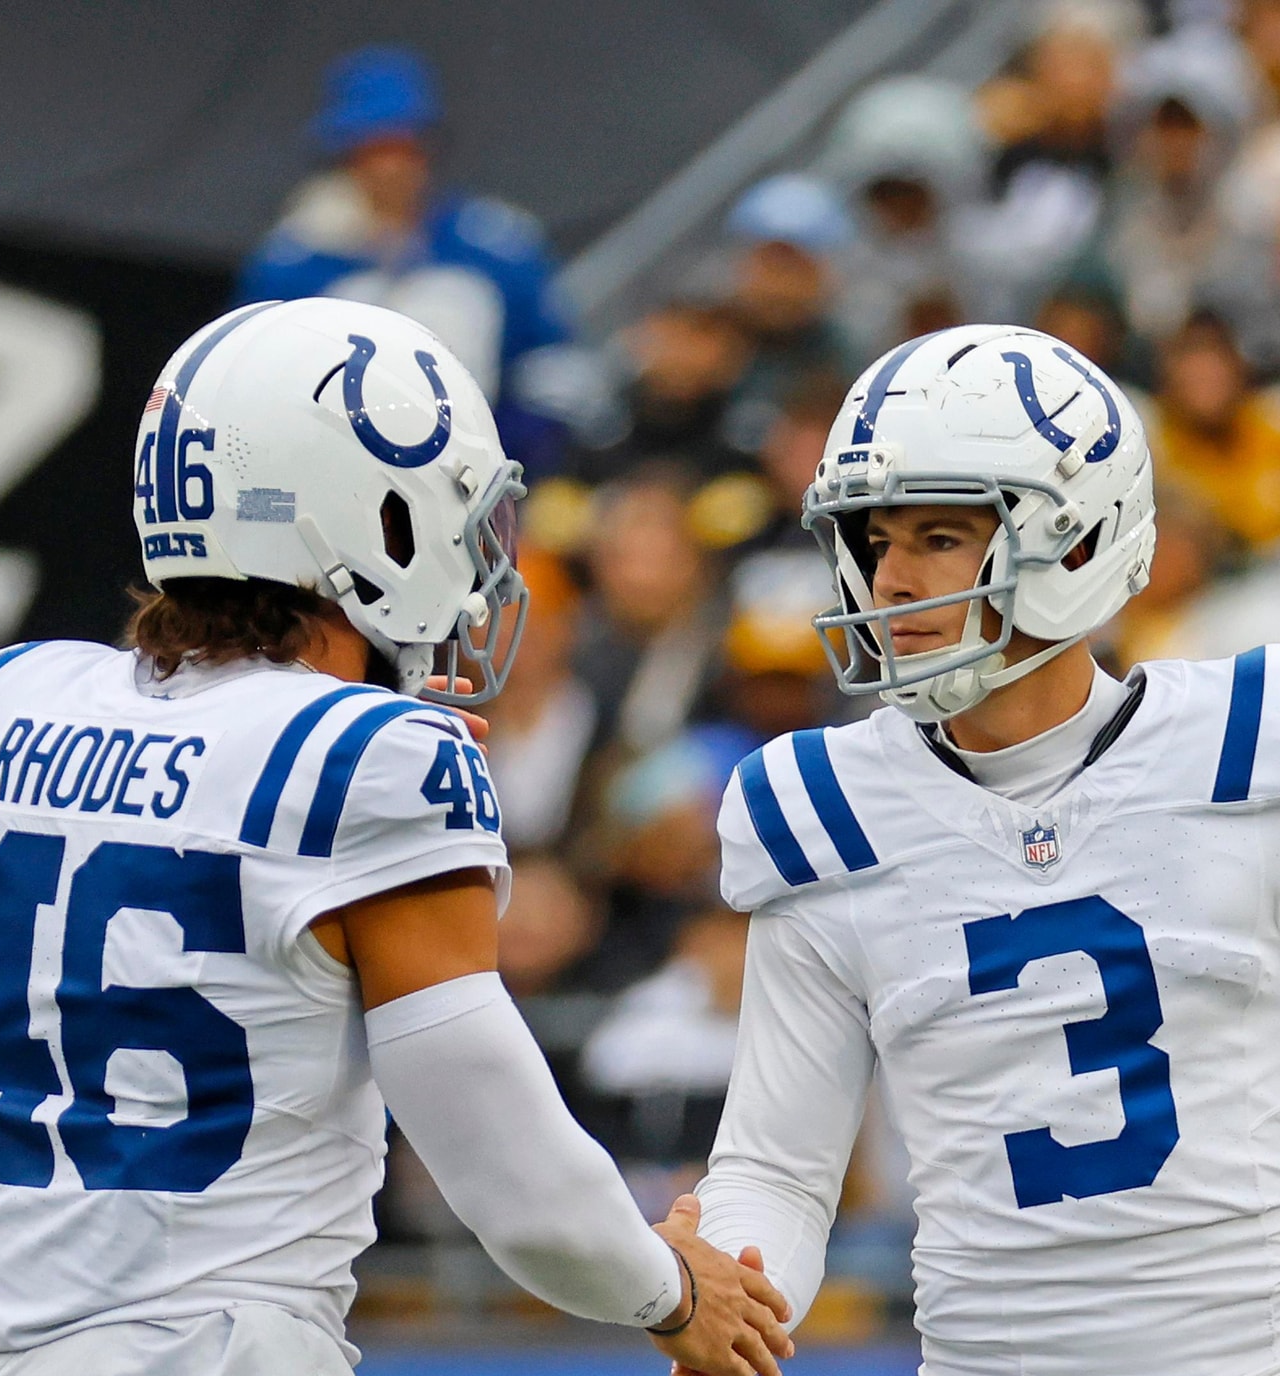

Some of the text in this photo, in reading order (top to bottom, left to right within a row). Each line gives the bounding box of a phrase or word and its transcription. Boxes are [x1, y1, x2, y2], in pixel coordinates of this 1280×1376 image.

[135, 428, 216, 524] 46
[419, 739, 500, 834] 46
[1027, 842, 1055, 863] NFL
[962, 894, 1180, 1209] 3
